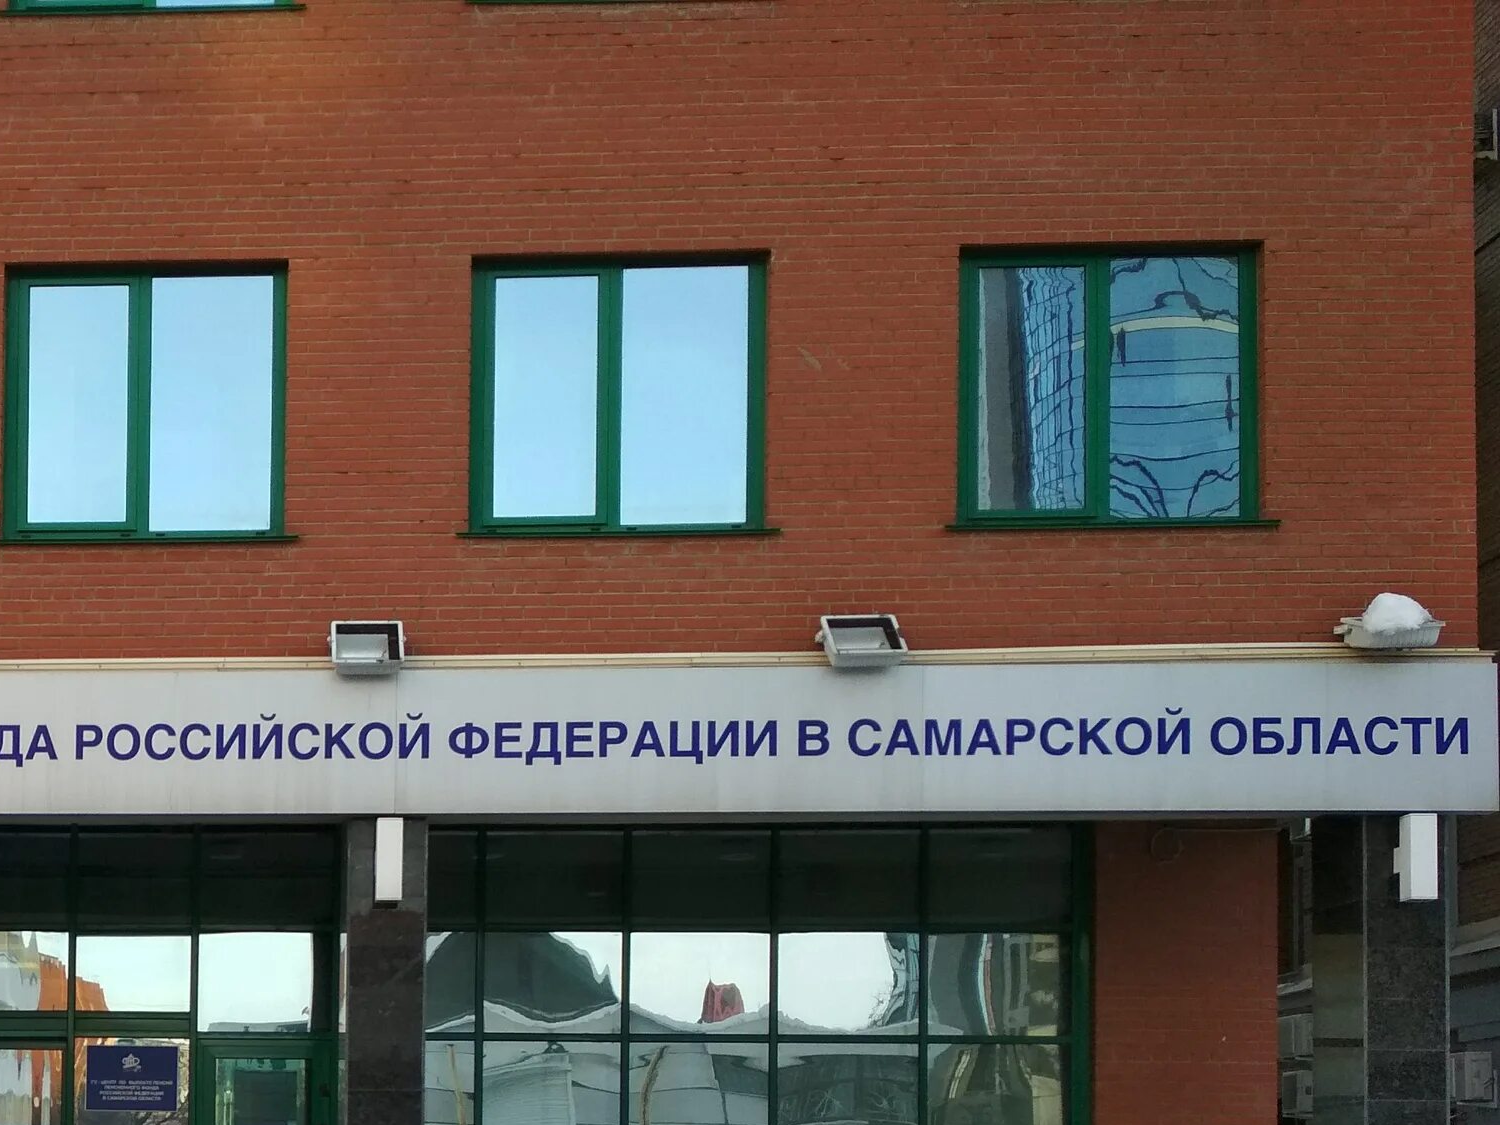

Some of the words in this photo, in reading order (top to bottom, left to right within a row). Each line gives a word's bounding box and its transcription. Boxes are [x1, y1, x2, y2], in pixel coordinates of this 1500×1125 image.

[75, 713, 430, 761] РОССИЙСКОЙ
[448, 720, 778, 765] ФЕДЕРАЦИИ
[797, 719, 830, 757] В
[847, 707, 1191, 757] САМАРСКОЙ
[1210, 716, 1469, 756] ОБЛАСТИ
